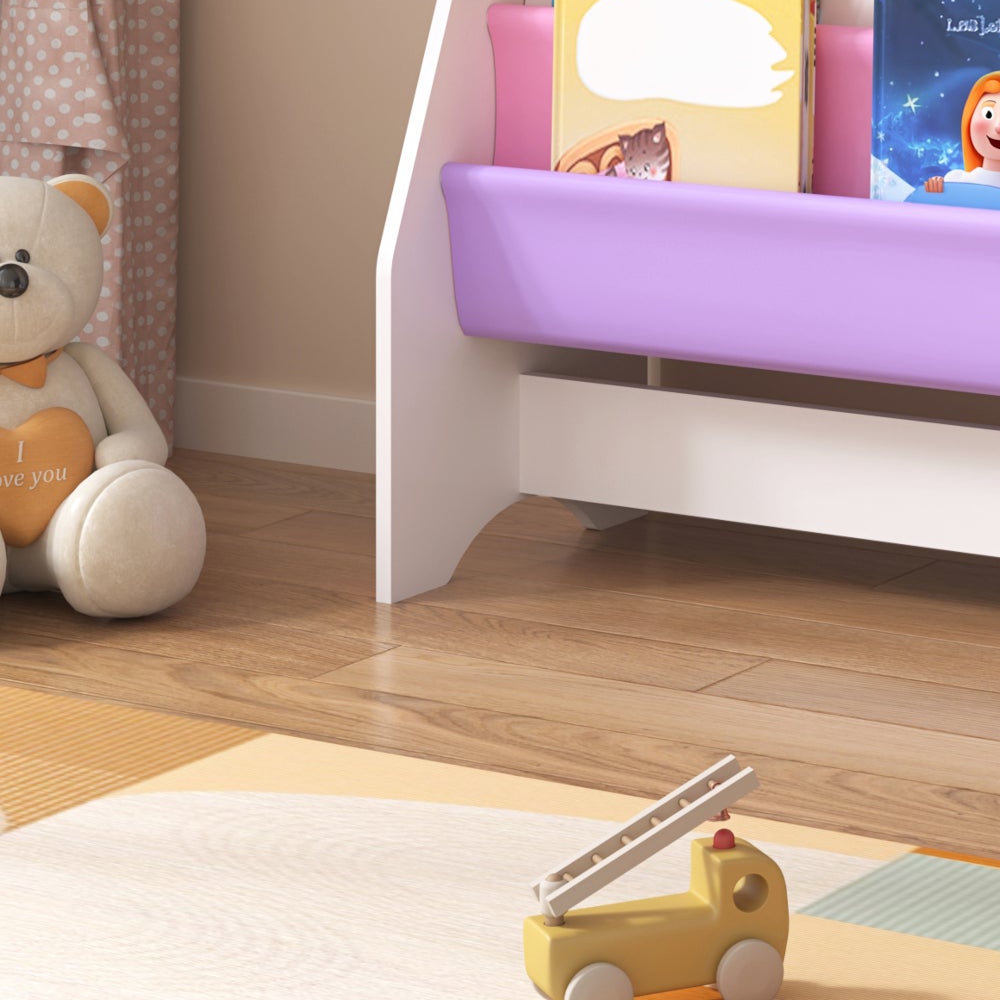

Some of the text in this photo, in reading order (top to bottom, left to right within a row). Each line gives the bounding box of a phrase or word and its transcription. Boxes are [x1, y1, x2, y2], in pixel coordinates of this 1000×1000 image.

[16, 440, 24, 463] I
[0, 467, 68, 490] ve you
